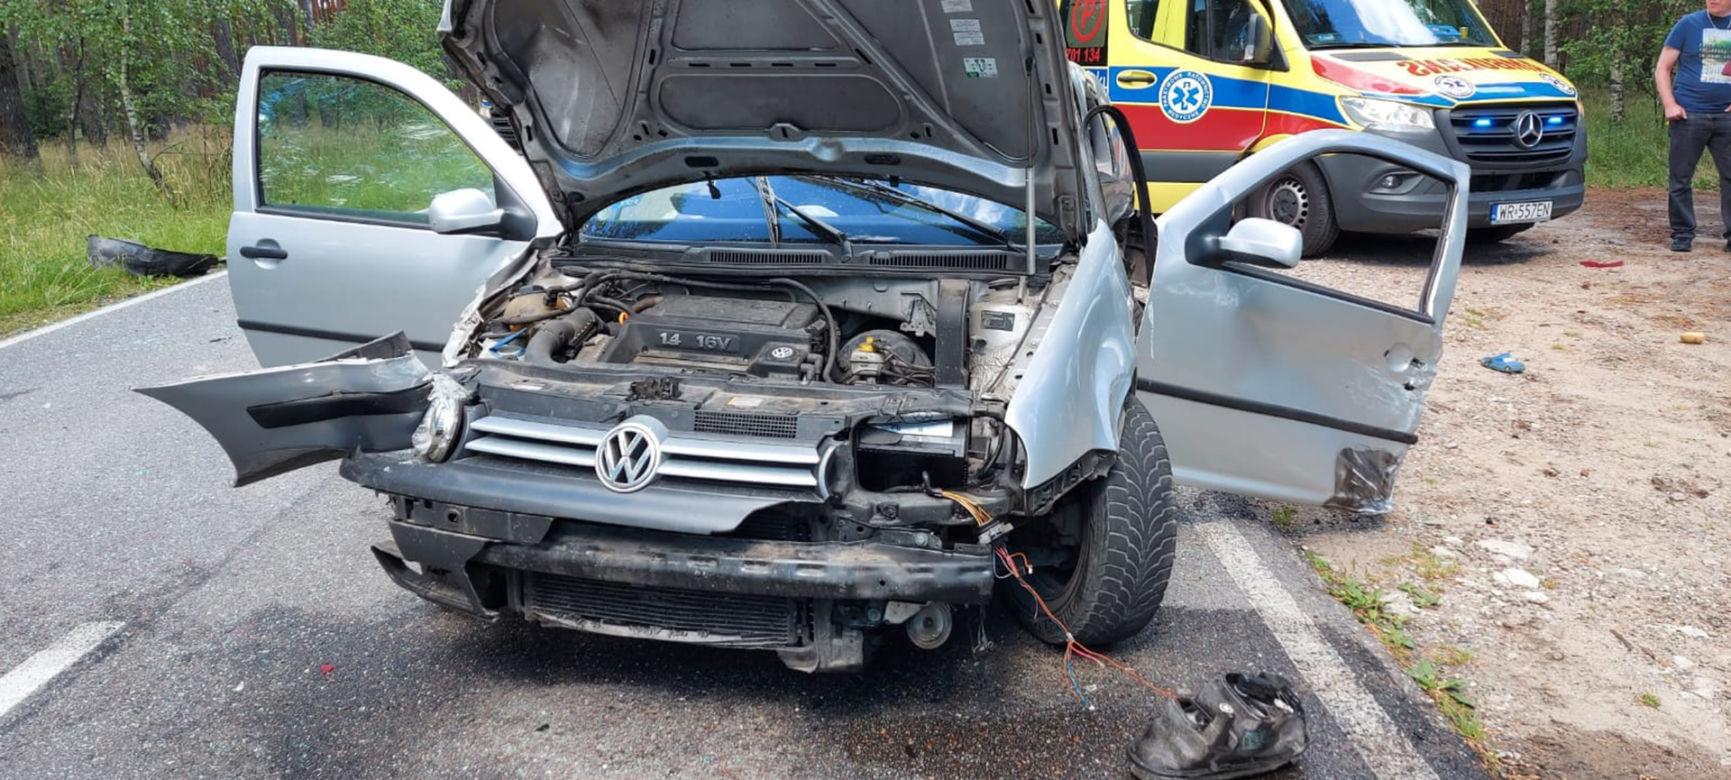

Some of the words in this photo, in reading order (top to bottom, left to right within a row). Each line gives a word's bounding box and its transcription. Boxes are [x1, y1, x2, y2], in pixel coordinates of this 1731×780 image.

[1084, 48, 1101, 62] 134
[1500, 205, 1513, 220] WR
[1518, 203, 1550, 218] 557EN
[696, 335, 731, 350] 16V
